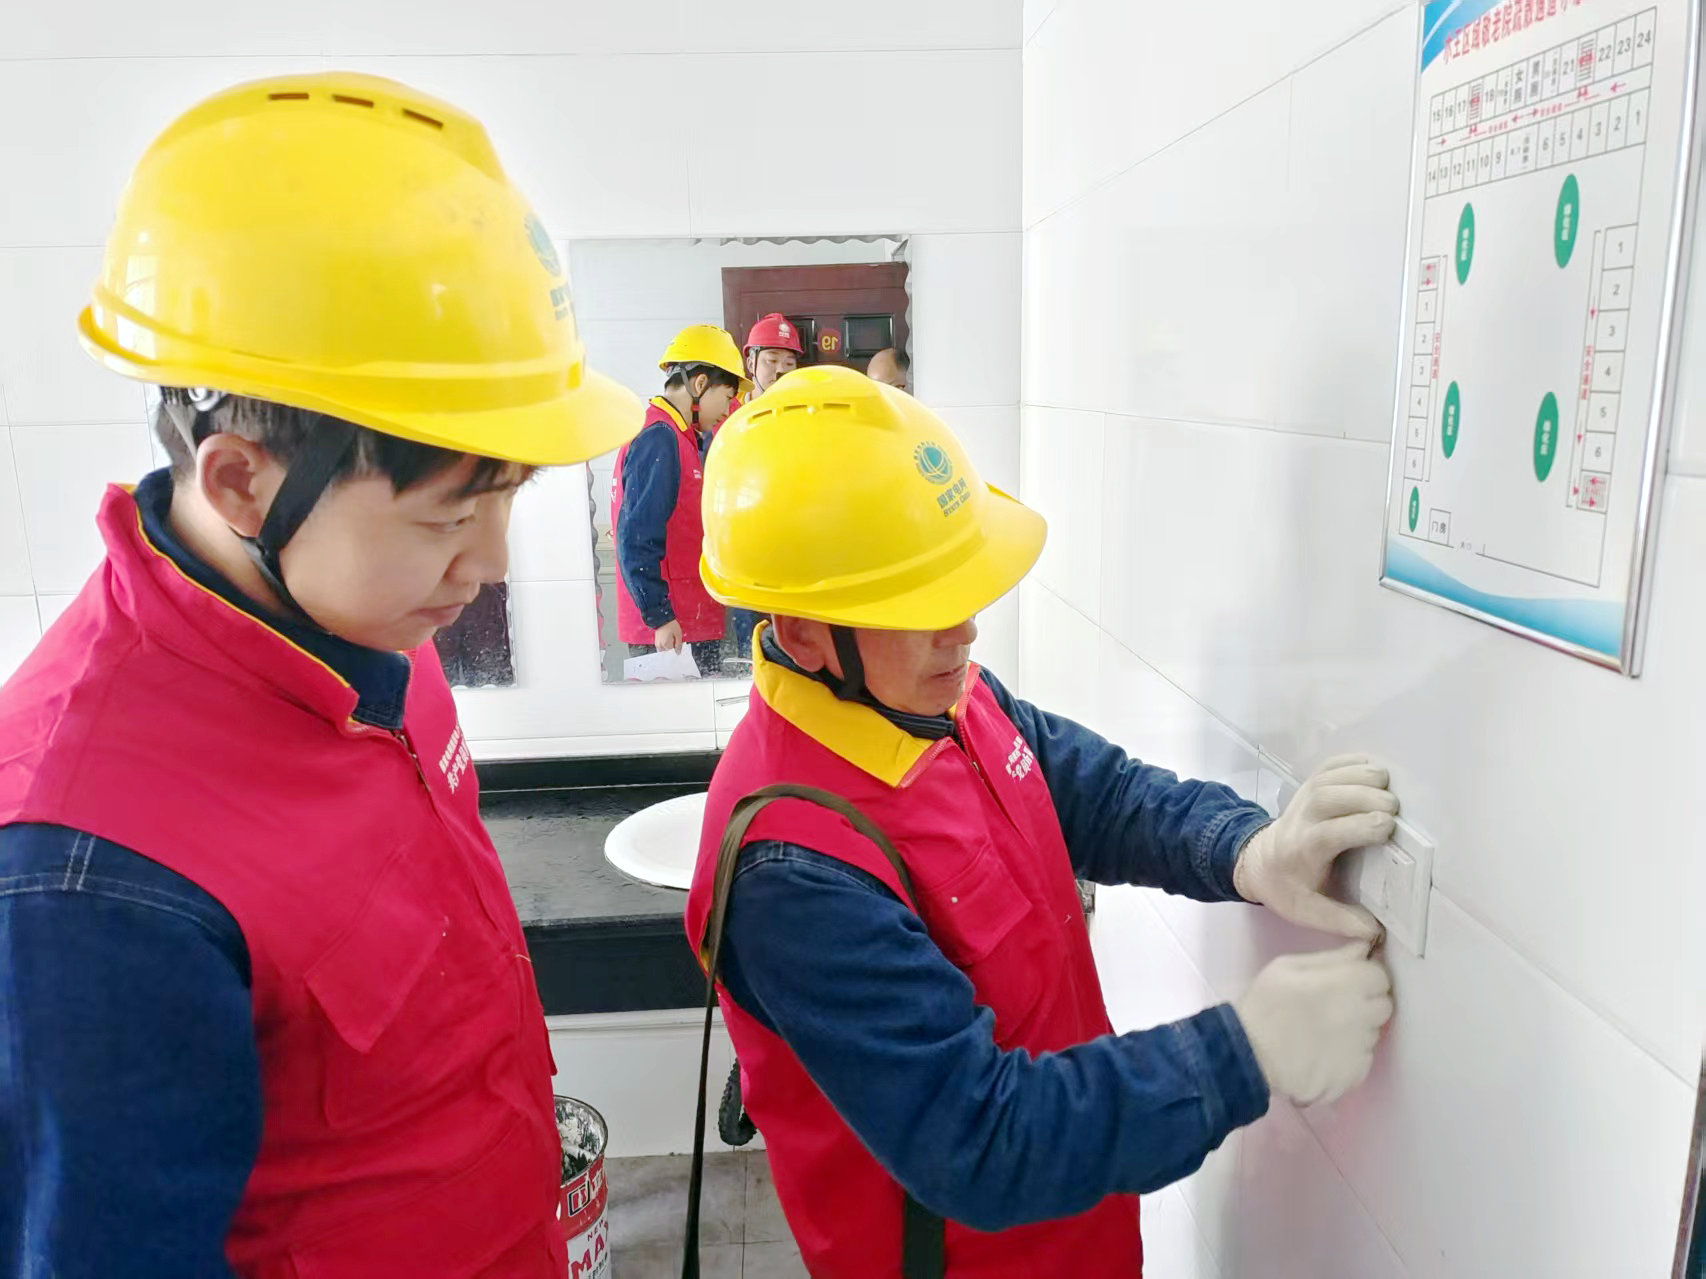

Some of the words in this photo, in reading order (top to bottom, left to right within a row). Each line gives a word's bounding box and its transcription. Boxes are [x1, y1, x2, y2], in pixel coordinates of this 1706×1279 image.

[1636, 29, 1651, 48] 24
[1598, 44, 1612, 62] 22
[1617, 37, 1632, 55] 23
[1562, 58, 1575, 75] 21
[1458, 99, 1466, 114] 17
[1432, 109, 1441, 122] 15
[1595, 121, 1602, 137] 3
[1614, 115, 1621, 131] 2
[1559, 132, 1566, 146] 5
[1577, 128, 1583, 141] 4
[1542, 137, 1549, 151] 6
[1480, 154, 1489, 168] 10
[1495, 151, 1502, 164] 9
[1453, 162, 1462, 176] 12
[1466, 158, 1475, 172] 11
[1428, 170, 1436, 182] 14
[1440, 166, 1448, 179] 13
[1612, 283, 1620, 296] 2
